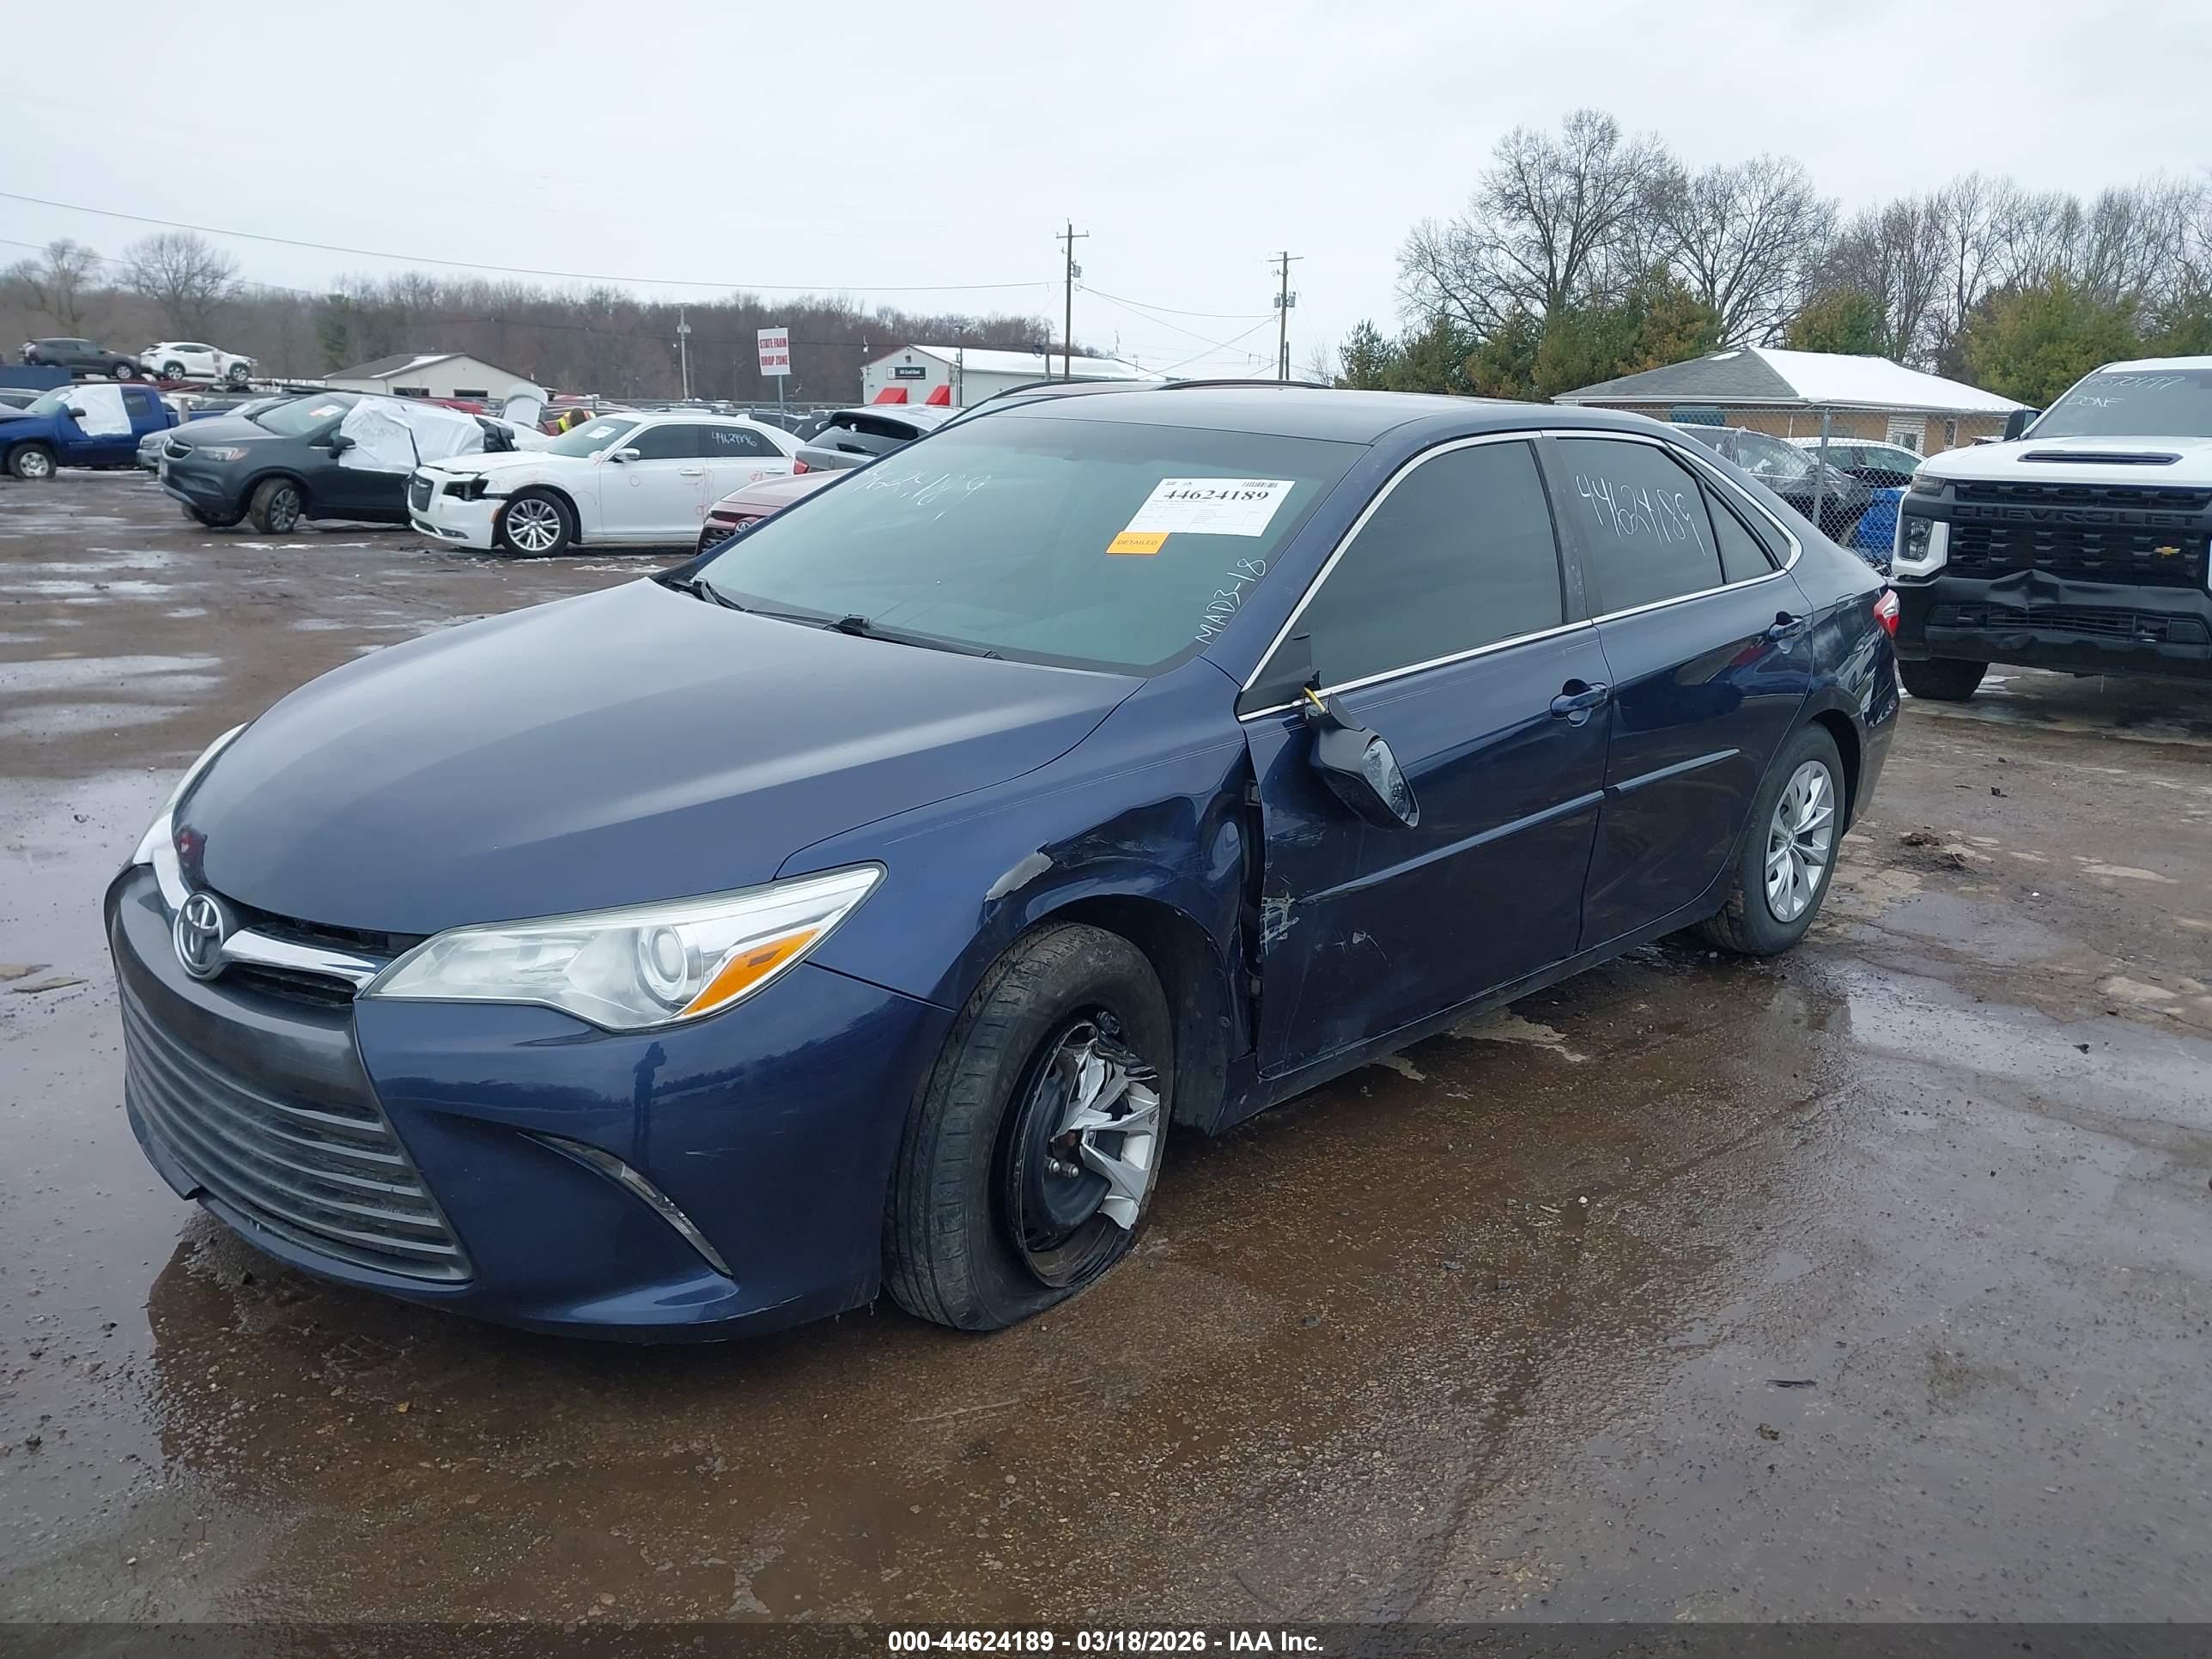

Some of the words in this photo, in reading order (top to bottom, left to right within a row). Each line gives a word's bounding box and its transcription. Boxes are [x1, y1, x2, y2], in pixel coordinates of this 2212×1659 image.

[759, 338, 773, 349] STATE
[774, 337, 787, 349] FARM
[761, 356, 775, 367] DROP
[776, 354, 788, 366] ZONE
[1163, 489, 1270, 501] 44624189
[1575, 473, 1706, 556] 44624189
[1950, 505, 2204, 529] CHEVROLET
